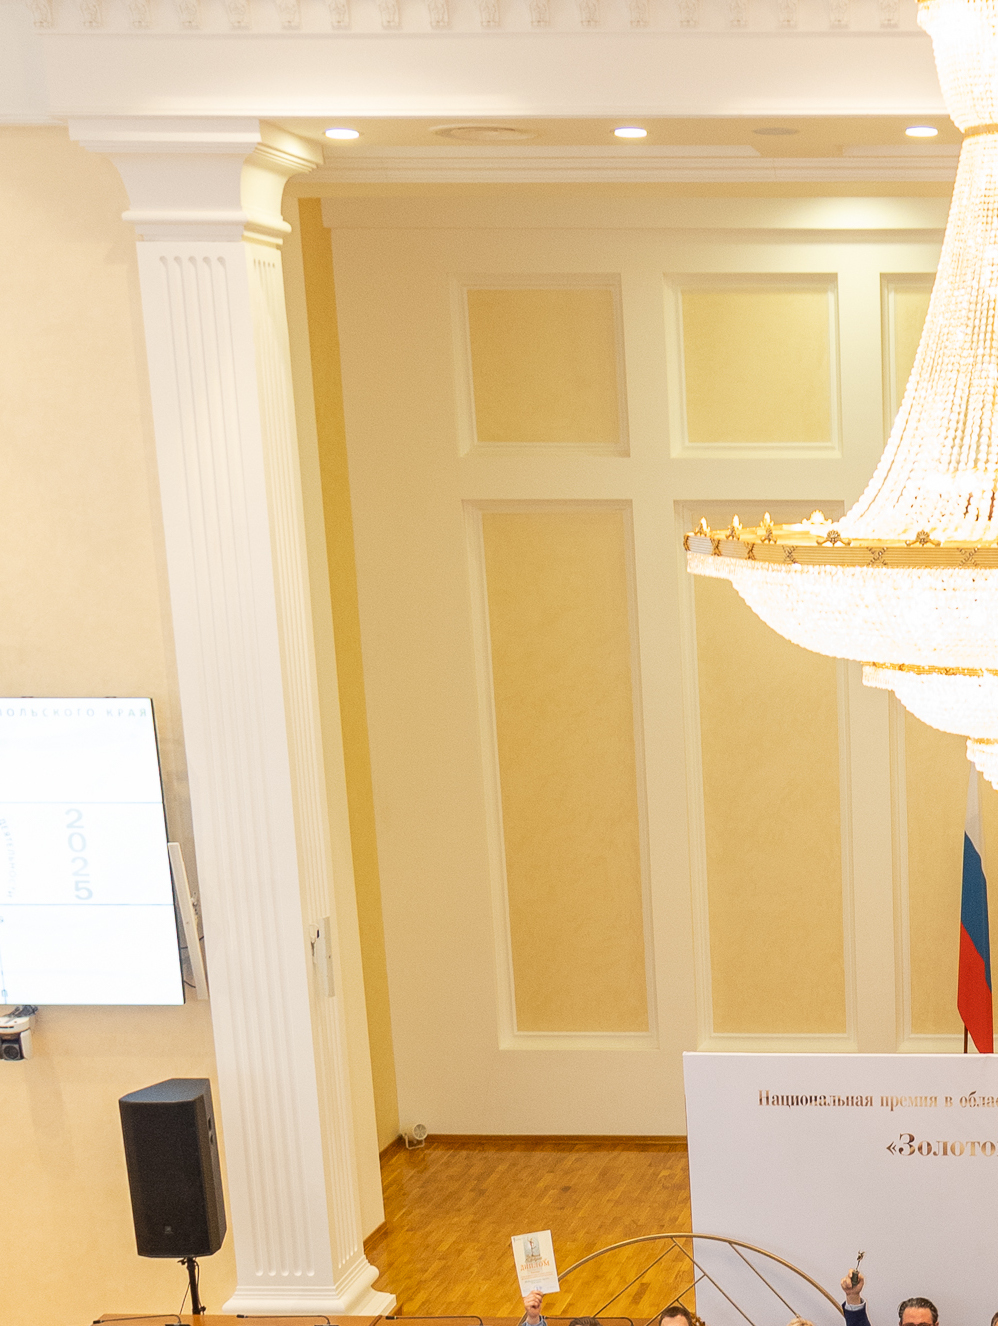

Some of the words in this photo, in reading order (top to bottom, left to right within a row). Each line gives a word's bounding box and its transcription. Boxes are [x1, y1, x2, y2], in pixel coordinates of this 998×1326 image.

[106, 708, 147, 717] КРАЯ
[64, 808, 94, 900] 2025
[758, 1090, 873, 1108] Национальная
[880, 1095, 938, 1110] премия
[945, 1096, 953, 1107] в
